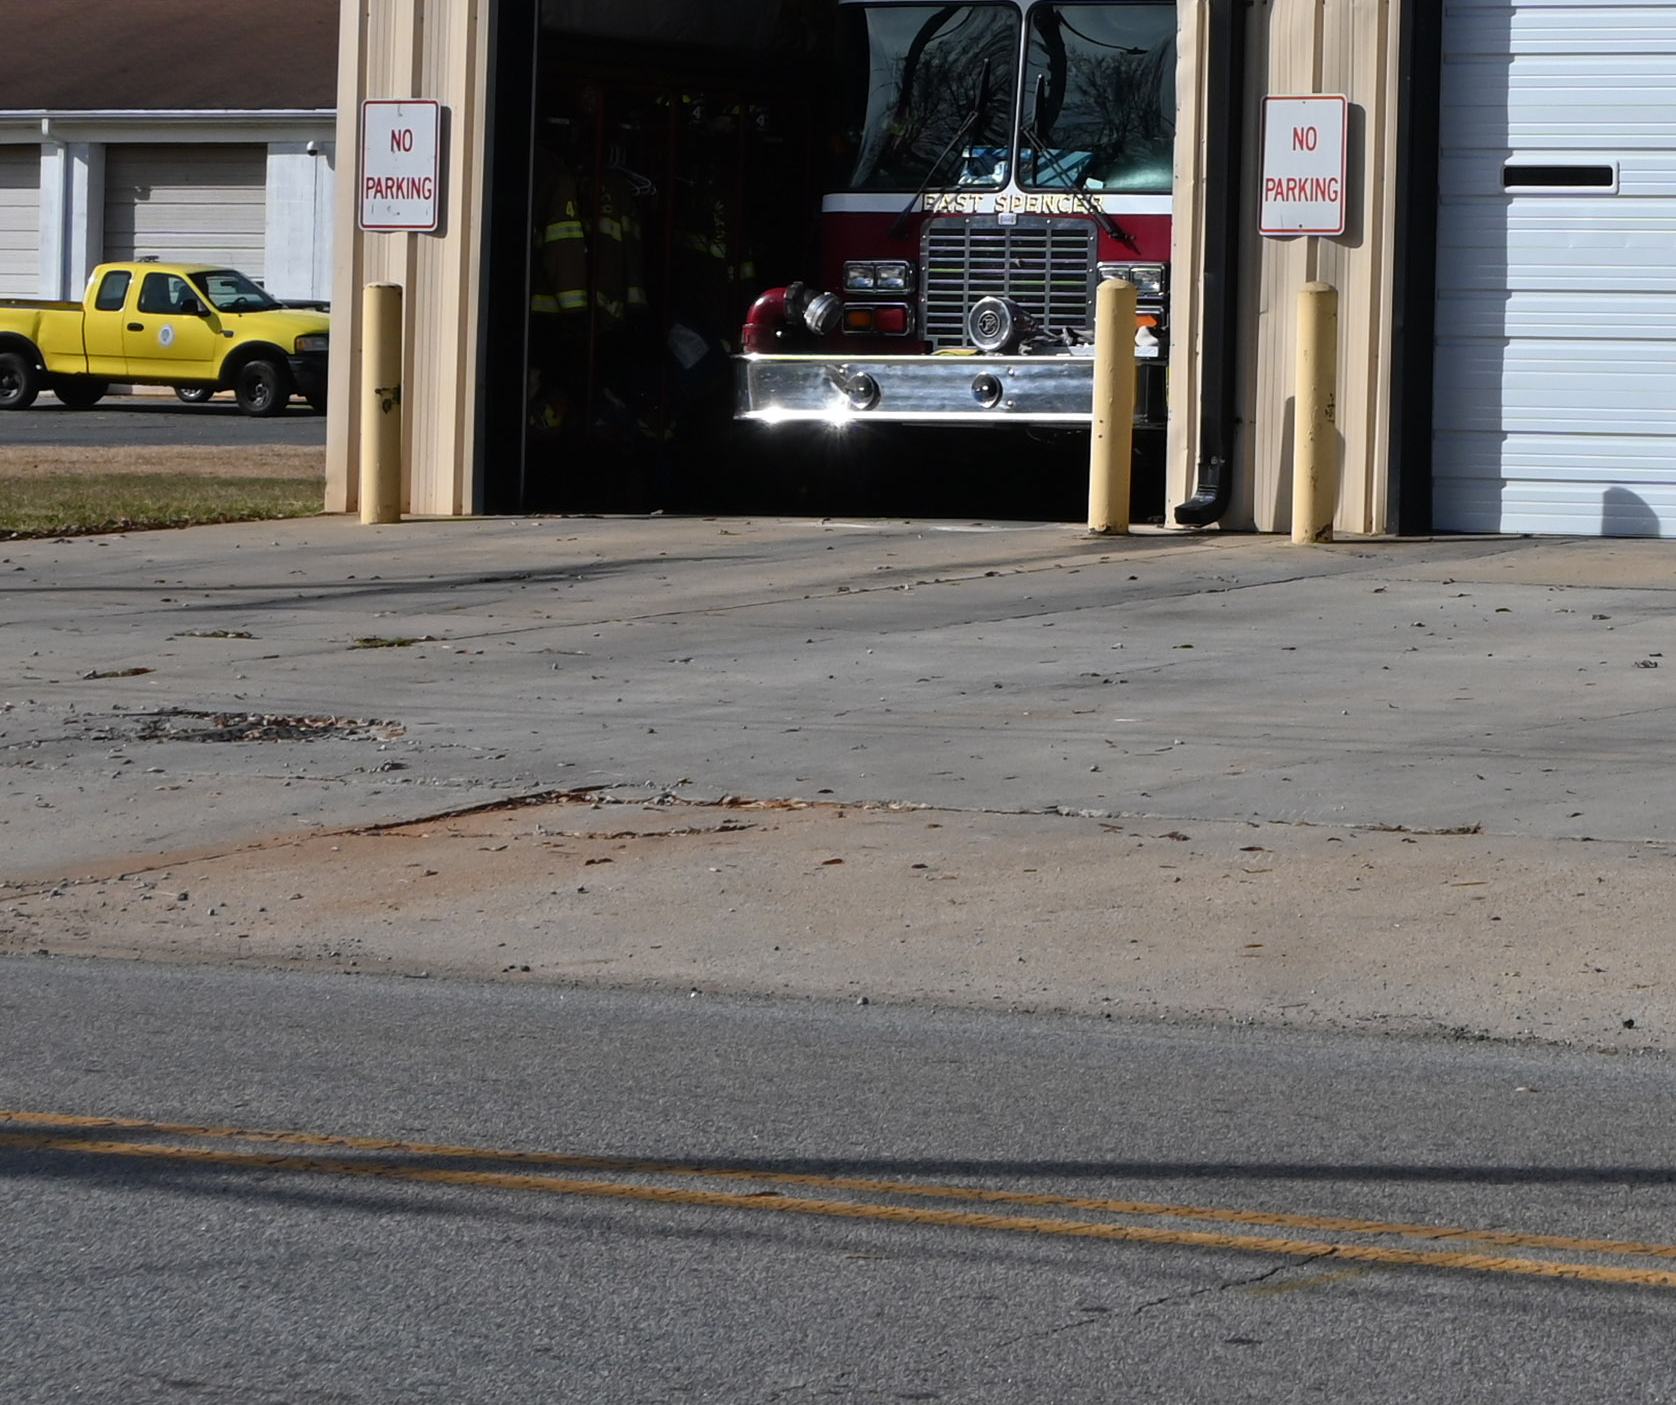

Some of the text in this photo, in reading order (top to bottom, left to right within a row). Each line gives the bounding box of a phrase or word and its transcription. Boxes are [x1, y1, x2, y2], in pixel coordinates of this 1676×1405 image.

[390, 128, 413, 152] NO
[1292, 126, 1317, 151] NO
[365, 177, 432, 200] PARKING
[1265, 177, 1339, 202] PARKING
[922, 194, 983, 213] EAST
